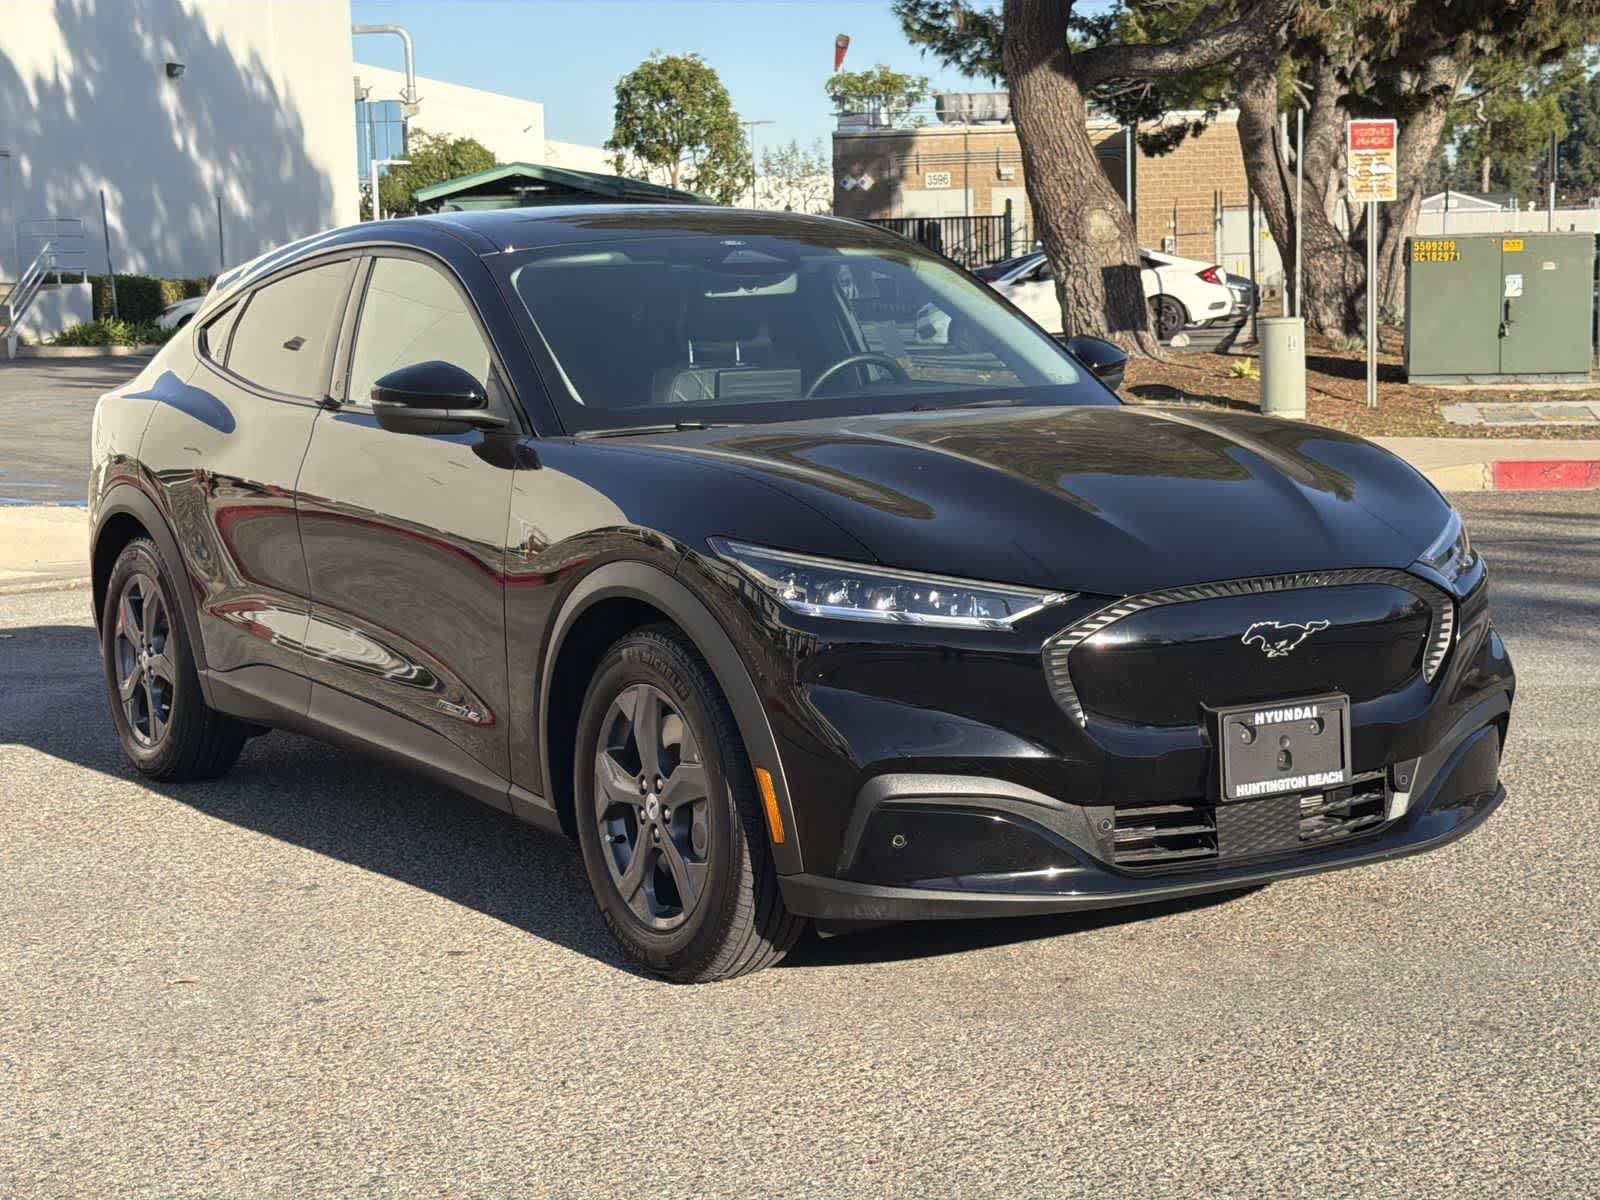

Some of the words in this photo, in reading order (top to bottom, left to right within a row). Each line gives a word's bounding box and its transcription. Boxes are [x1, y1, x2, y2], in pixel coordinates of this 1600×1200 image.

[927, 174, 949, 186] 3596
[1254, 705, 1318, 725] HYUNDAI
[1236, 775, 1306, 797] HUNTINGTON
[1308, 770, 1344, 787] BEACH
